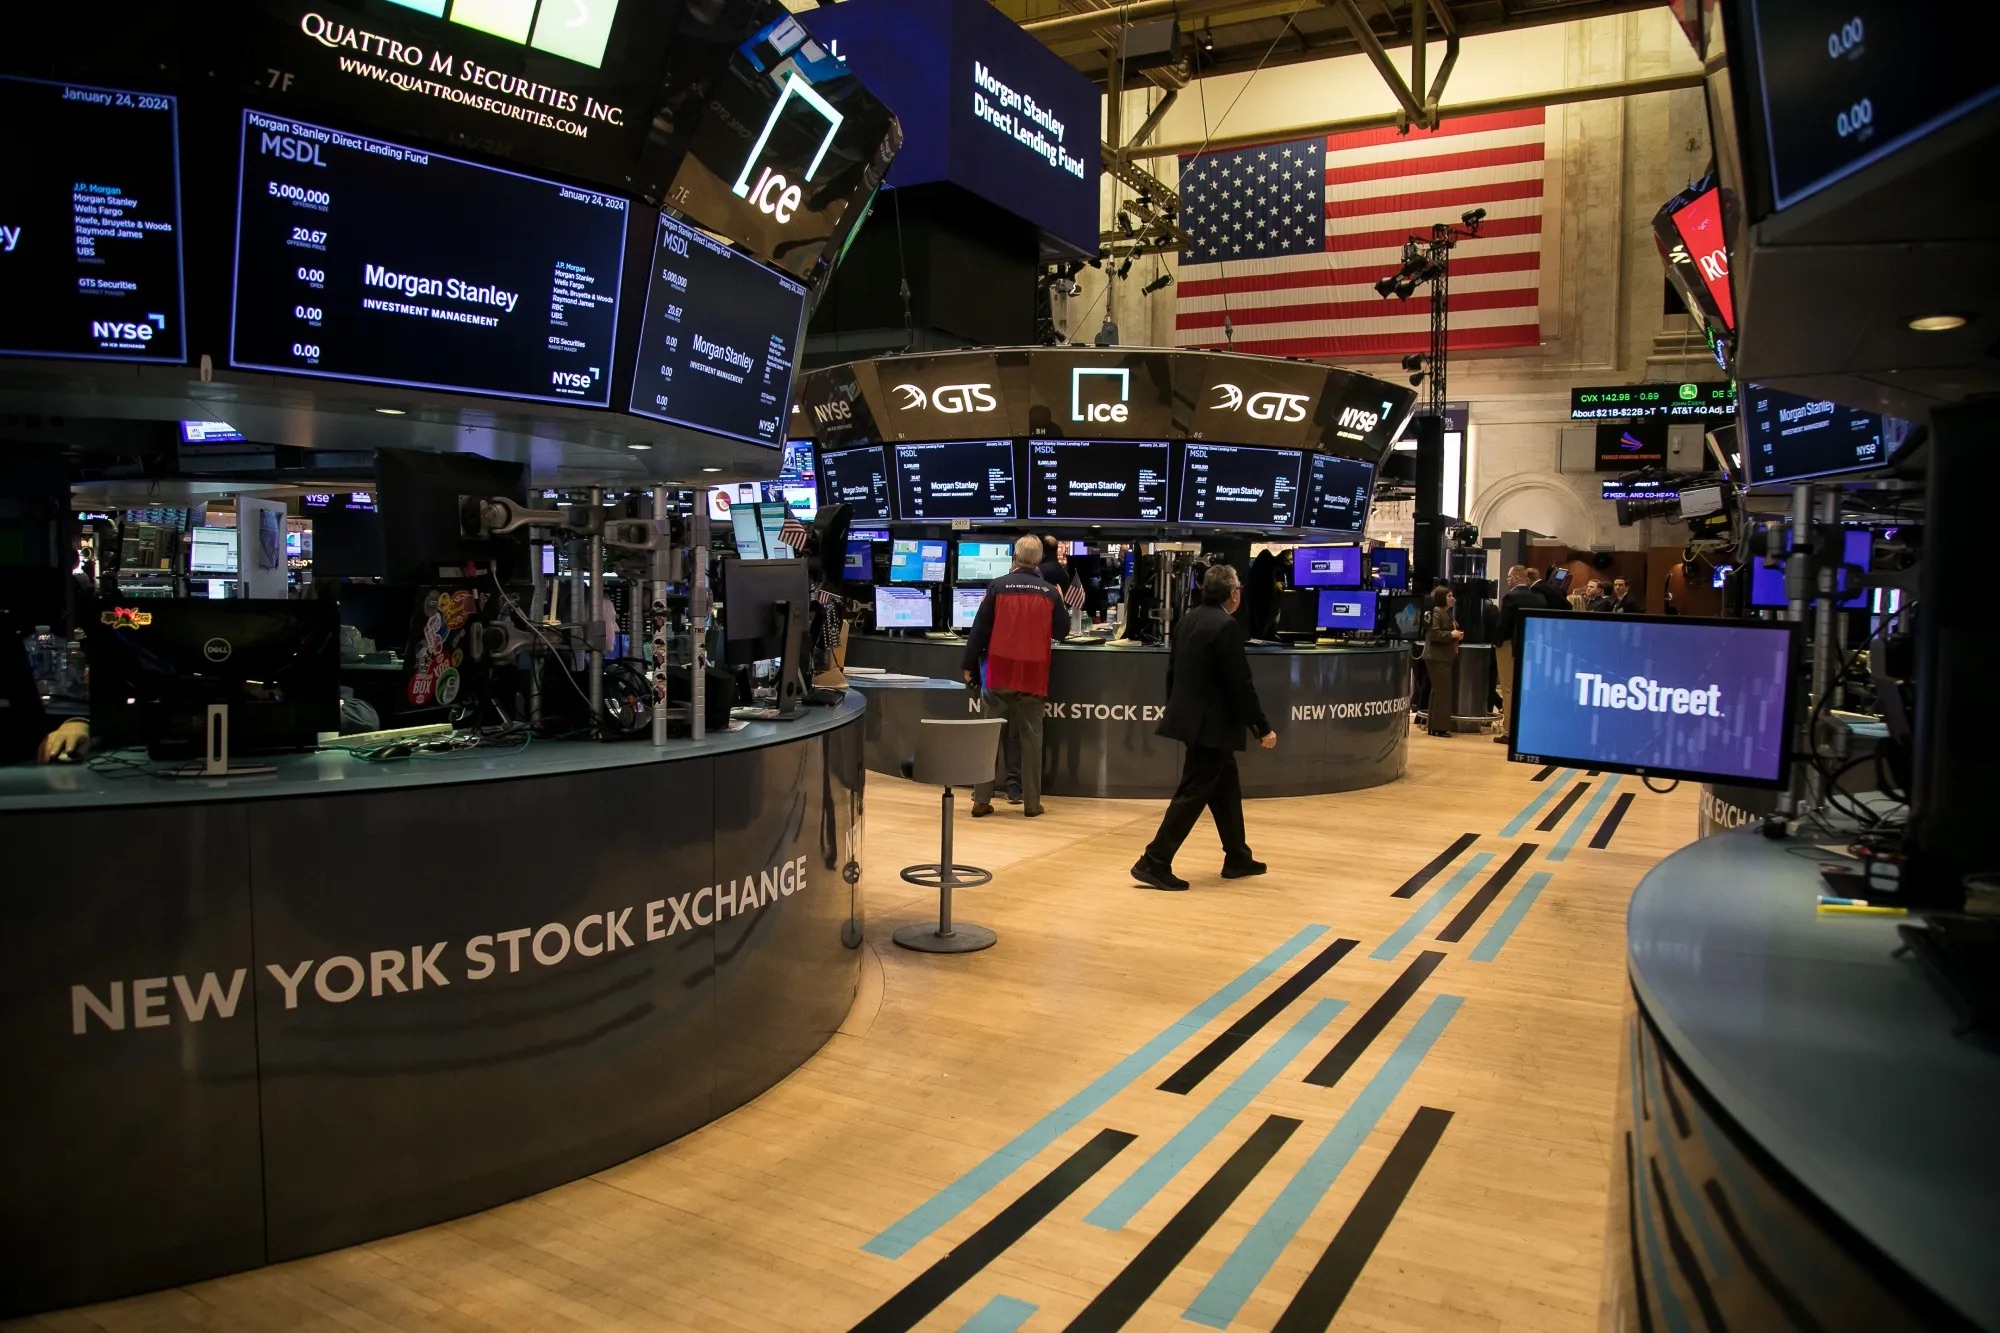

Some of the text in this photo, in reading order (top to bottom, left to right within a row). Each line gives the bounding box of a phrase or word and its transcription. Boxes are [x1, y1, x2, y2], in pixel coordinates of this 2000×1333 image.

[1828, 16, 1863, 58] 0.00
[300, 12, 625, 126] QUATTRO M SECURITIES INC.
[266, 68, 295, 93] 7F
[62, 87, 169, 110] January 24, 2024
[975, 60, 1065, 143] Morgan Stanley
[1837, 98, 1872, 137] 0.00
[249, 114, 429, 165] Morgan Stanley Direct Lending Fund
[974, 91, 1084, 180] Direct Lending Fund
[261, 132, 327, 167] MSDL
[73, 183, 121, 195] J.P. Morgan
[269, 181, 330, 205] 5,000,000
[677, 186, 690, 205] 7E
[73, 193, 137, 208] Morgan Stanley
[559, 187, 624, 211] January 24, 2024
[74, 204, 123, 217] Wells Fargo
[75, 216, 100, 226] Keefe,
[102, 219, 135, 229] Bruyette
[145, 221, 172, 231] Woods
[75, 226, 143, 239] Raymond James
[292, 227, 327, 244] 20.67
[661, 216, 678, 231] Morgan
[677, 224, 693, 240] Stanley
[705, 238, 720, 254] Lending
[720, 248, 731, 259] Fund
[76, 236, 95, 245] RBC
[663, 230, 689, 259] MSDL
[77, 247, 95, 256] UBS
[298, 267, 325, 283] 0.00
[565, 263, 586, 273] Morgan
[79, 278, 137, 290] GTS Securities
[554, 278, 584, 290] Wells Fargo
[555, 269, 595, 284] Morgan Stanley
[364, 263, 518, 313] Morgan Stanley
[578, 298, 595, 308] James
[596, 294, 613, 303] Woods
[295, 306, 322, 321] 0.00
[363, 298, 499, 327] INVESTMENT MANAGEMENT
[552, 303, 564, 311] RBC
[551, 311, 562, 319] UBS
[548, 336, 585, 348] GTS Securities
[666, 335, 678, 348] 0.00
[293, 343, 320, 358] 0.00
[692, 333, 725, 360] Morgan
[724, 345, 754, 374] Stanley
[661, 365, 672, 377] 0.00
[689, 360, 744, 384] INVESTMENT MANAGEMENT
[656, 394, 668, 406] 0.00
[932, 383, 997, 414] GTS
[1581, 394, 1598, 402] CVX
[1601, 393, 1630, 401] 142.98
[1712, 390, 1724, 398] DE
[1246, 391, 1310, 422] GTS
[1572, 409, 1595, 418] About
[1671, 406, 1724, 415] AT&T 4Q Adj.
[1779, 400, 1835, 423] Morgan Stanley
[1034, 446, 1056, 454] MSDL
[1189, 449, 1208, 458] MSDL
[930, 481, 979, 491] Morgan Stanley
[1069, 480, 1126, 491] Morgan Stanley
[1216, 485, 1264, 497] Morgan Stanley
[413, 681, 432, 694] BOX
[1071, 703, 1138, 721] STOCK
[1291, 699, 1393, 721] NEW YORK STOCK
[1514, 754, 1540, 764] TF 173
[71, 855, 807, 1035] NEW YORK STOCK EXCHANGE
